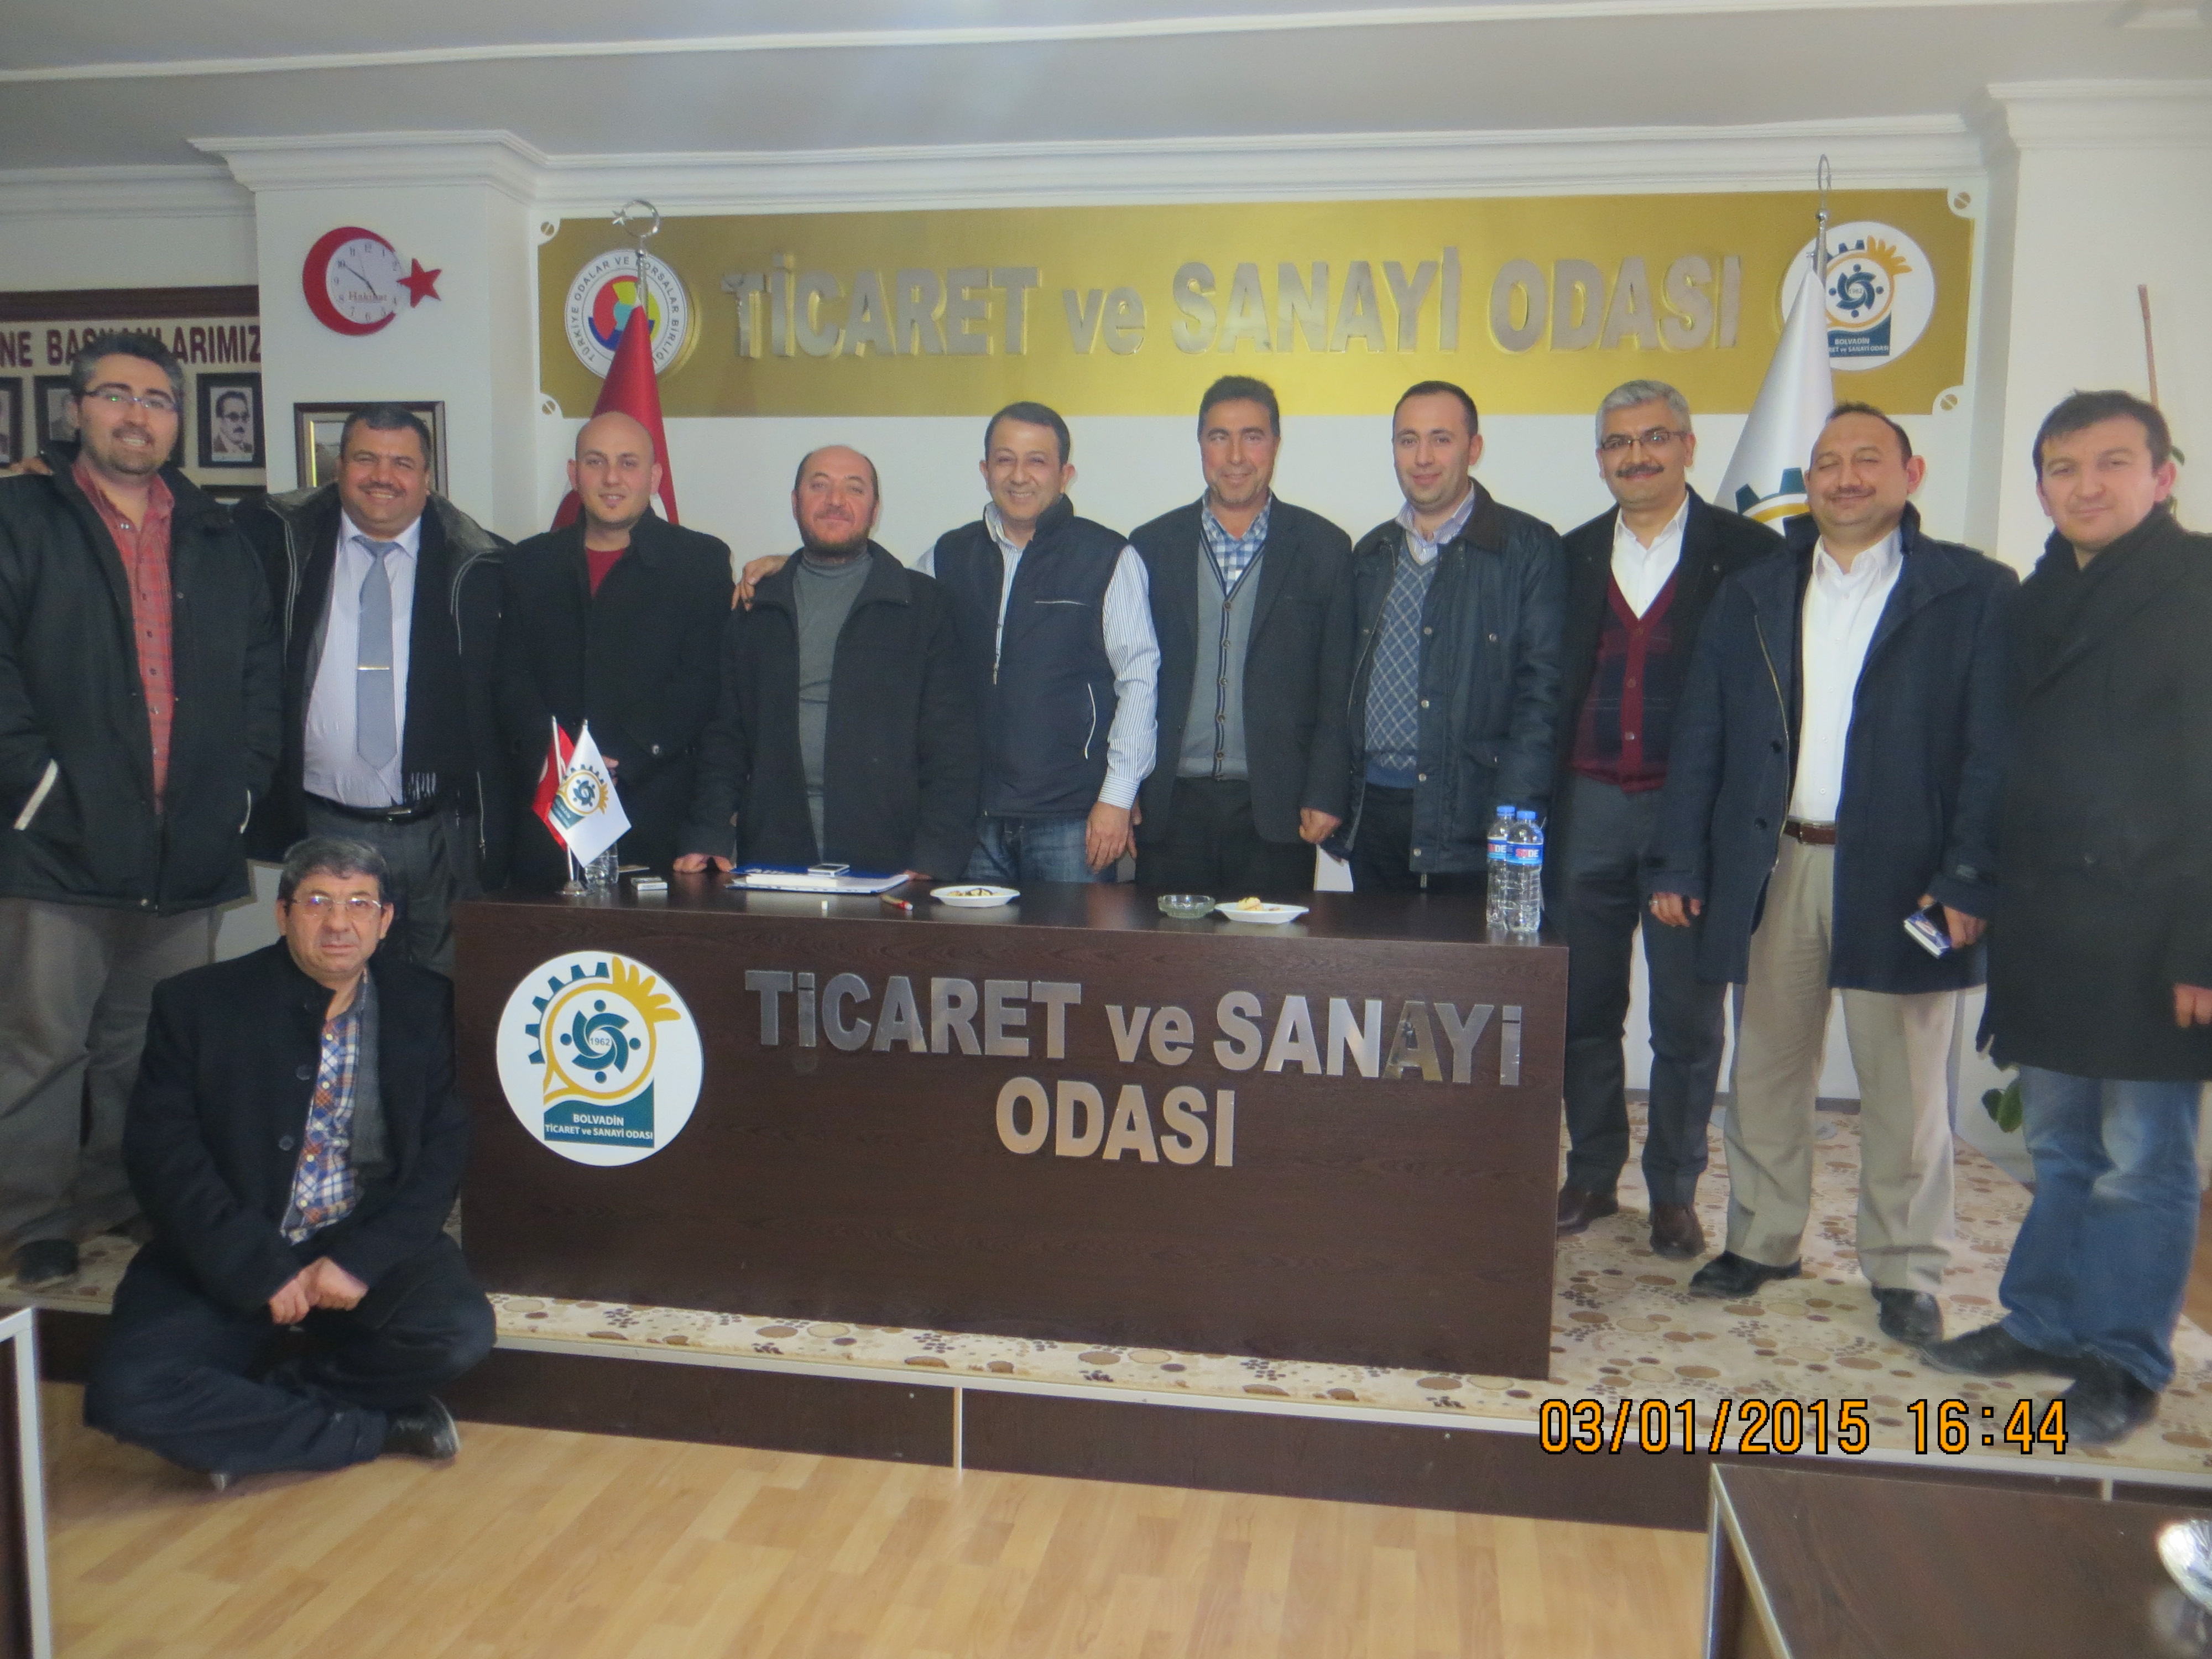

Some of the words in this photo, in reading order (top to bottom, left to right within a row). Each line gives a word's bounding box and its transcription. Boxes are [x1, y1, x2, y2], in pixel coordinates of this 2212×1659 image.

[615, 257, 629, 265] VE
[574, 260, 611, 301] ODALAR
[637, 258, 680, 314] ORSALAR
[721, 254, 1042, 358] TİCARET
[1063, 286, 1146, 356] ve
[1171, 246, 1460, 354] SANAYİ
[1488, 255, 1741, 354] ODASI
[571, 307, 596, 363] TÜRKİYE
[1834, 337, 1870, 346] BOLVADİN
[1516, 848, 1539, 858] SUDE
[590, 1037, 610, 1046] 1962
[745, 969, 1081, 1058] TİCARET
[1105, 1005, 1194, 1066] ve
[1213, 991, 1522, 1086] SANAYİ
[545, 1124, 580, 1134] TİCARET
[593, 1128, 624, 1138] SANAYİ
[626, 1131, 653, 1139] ODASI
[573, 1113, 624, 1126] BOLVADİN
[996, 1077, 1235, 1167] ODASI
